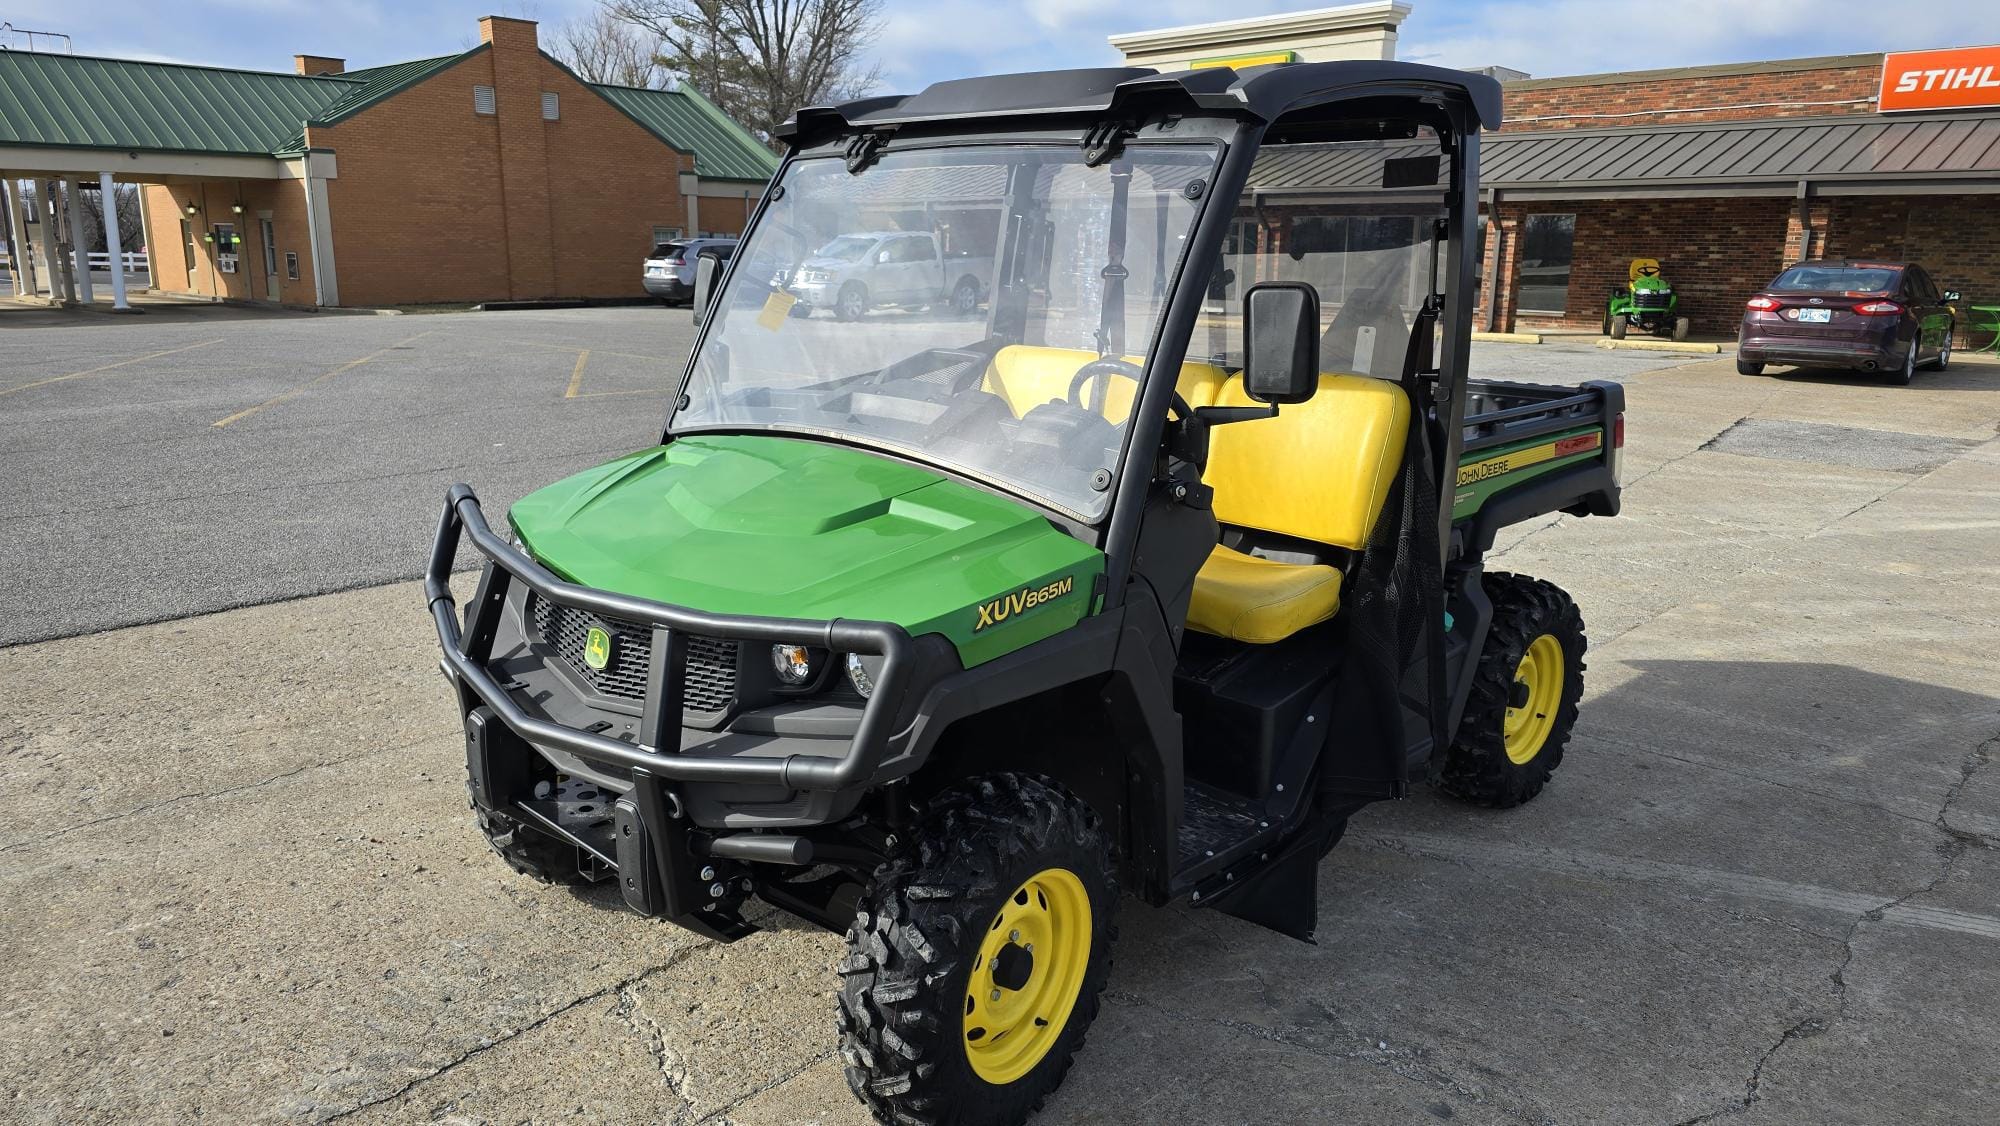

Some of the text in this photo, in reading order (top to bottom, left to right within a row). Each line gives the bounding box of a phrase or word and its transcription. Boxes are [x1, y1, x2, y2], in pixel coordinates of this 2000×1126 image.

[1894, 66, 2000, 92] STIHL
[1456, 459, 1509, 485] JOHN DEERE
